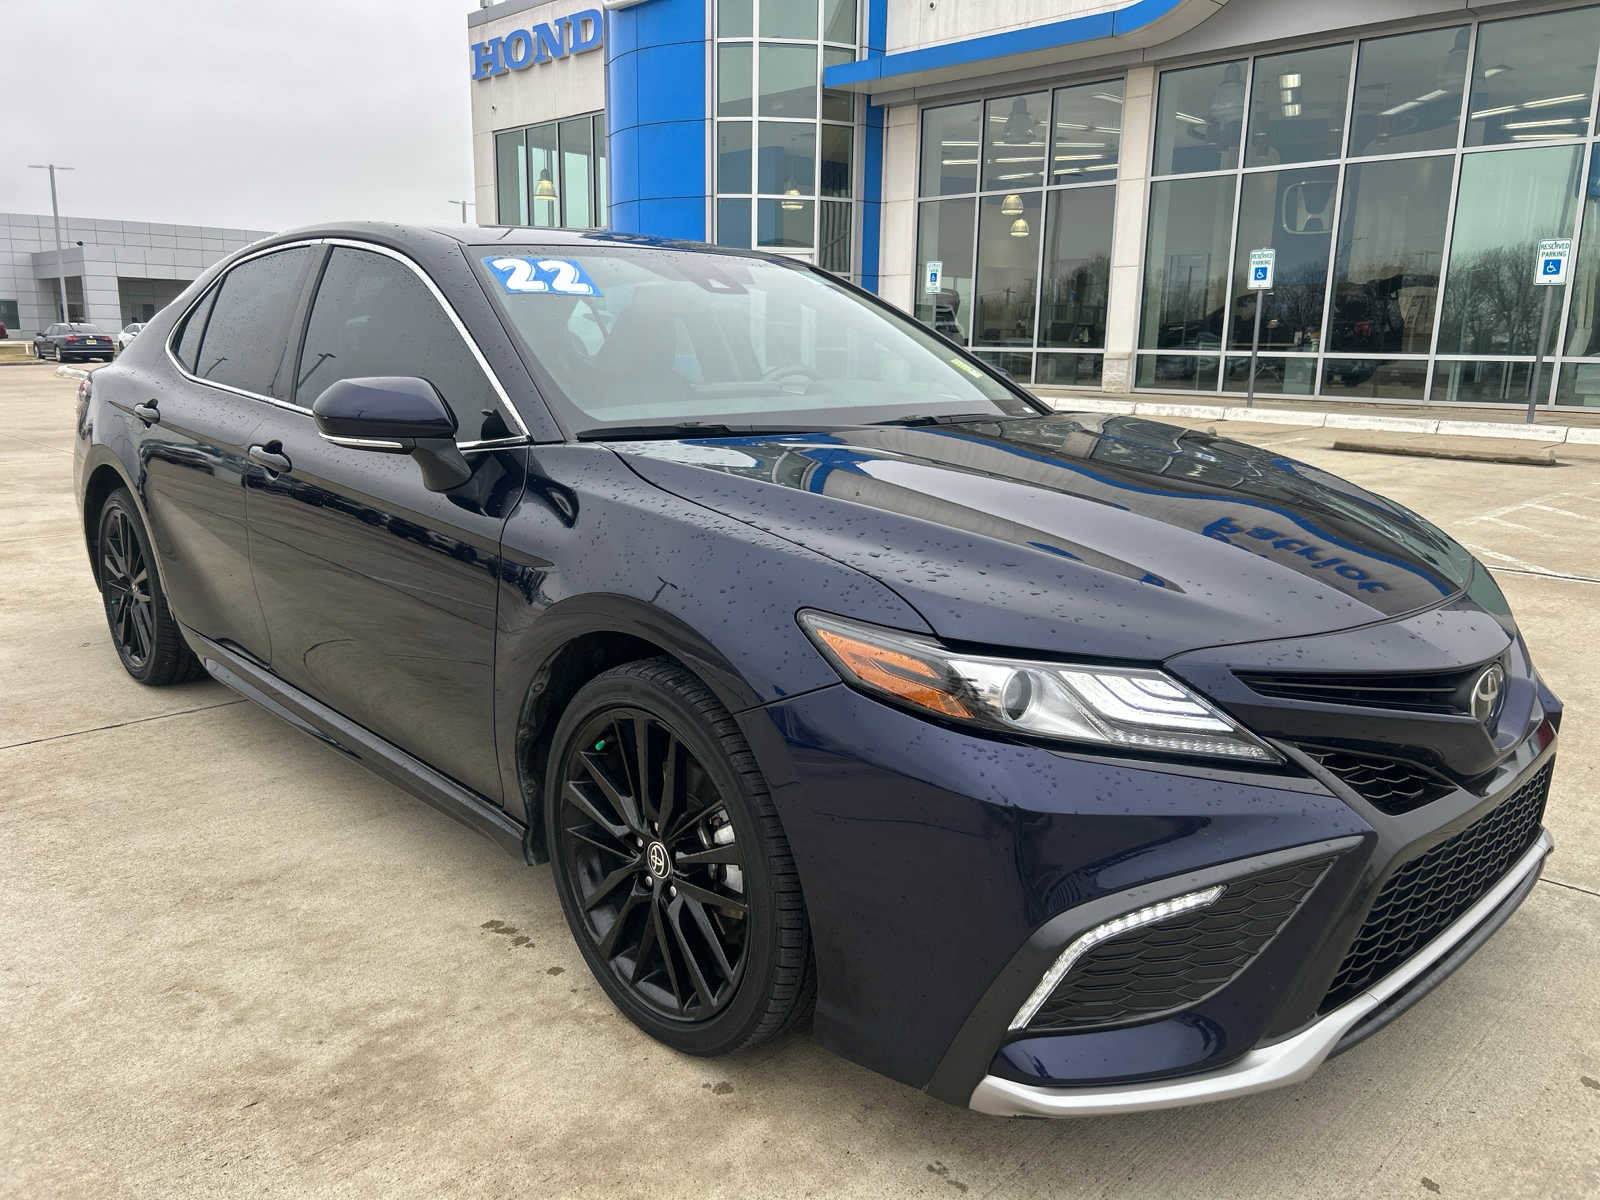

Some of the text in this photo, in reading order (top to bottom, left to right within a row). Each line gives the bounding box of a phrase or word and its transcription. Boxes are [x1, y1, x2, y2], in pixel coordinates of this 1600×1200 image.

[1540, 242, 1570, 250] RESERVED
[1541, 250, 1567, 258] PARKING
[490, 257, 595, 295] 22
